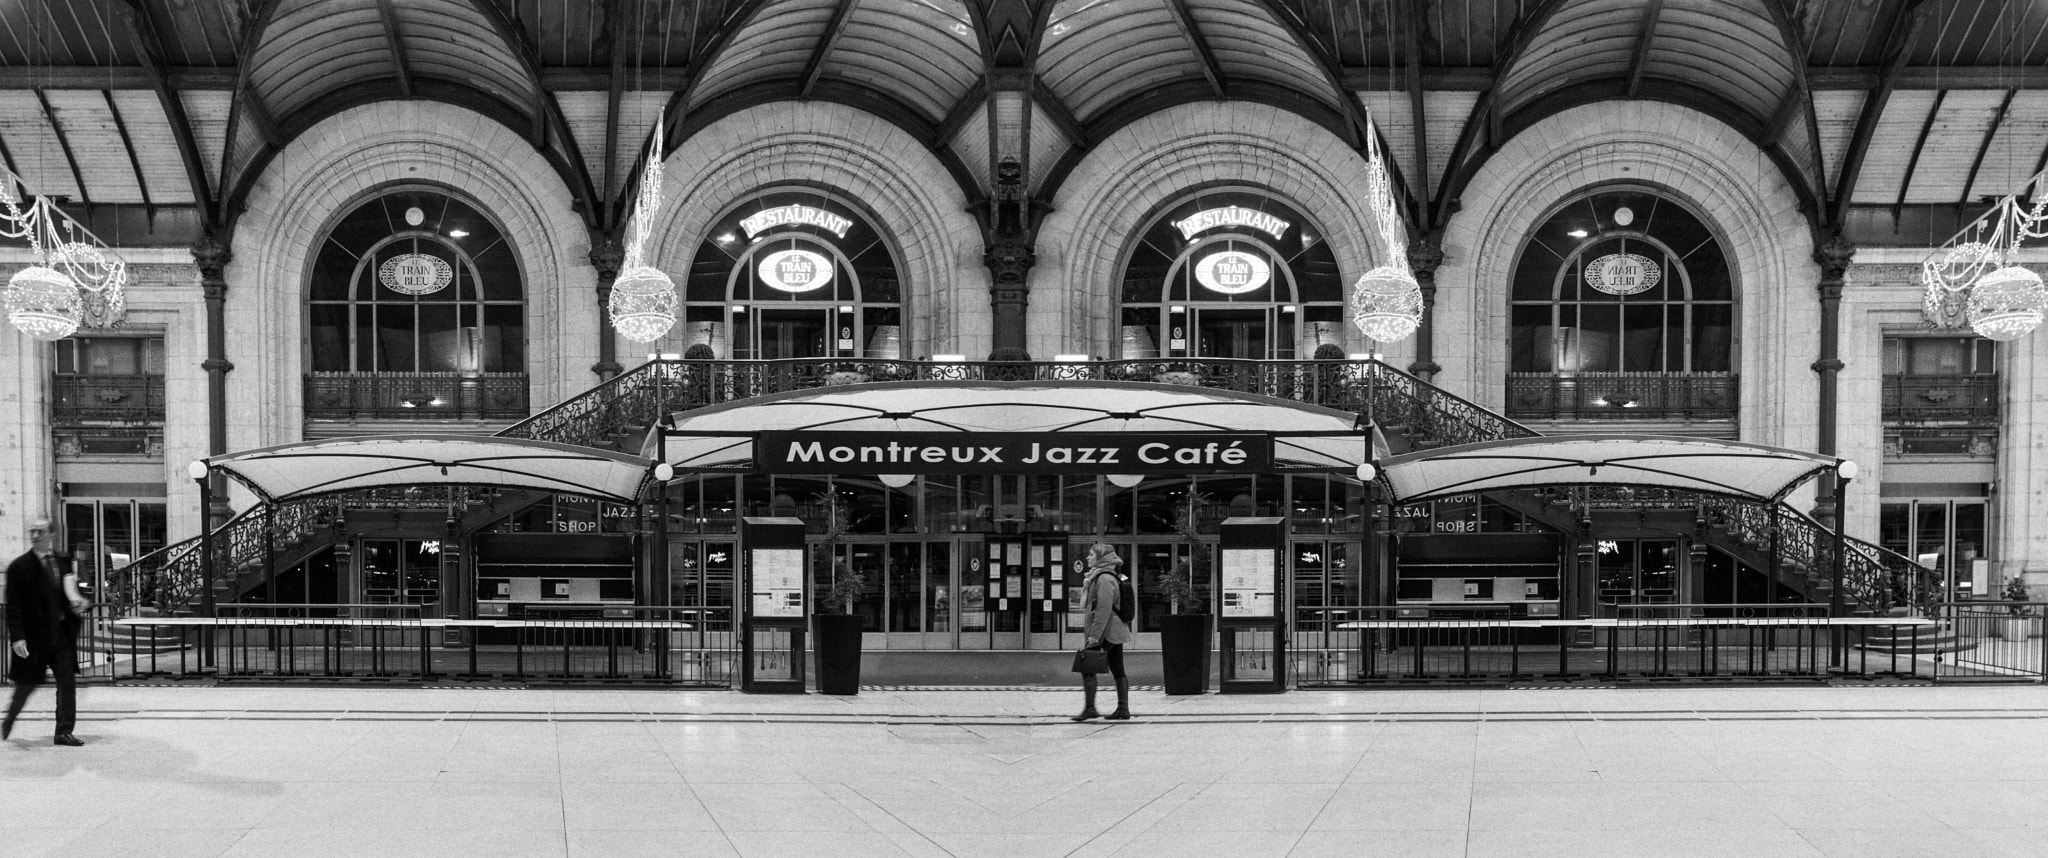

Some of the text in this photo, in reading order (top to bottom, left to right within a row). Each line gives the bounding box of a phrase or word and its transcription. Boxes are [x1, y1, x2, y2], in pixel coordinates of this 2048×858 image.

[744, 208, 846, 237] RESTAURANT
[1182, 209, 1283, 239] RESTAURANT
[401, 265, 431, 275] TRAIN
[781, 262, 811, 272] TRAIN
[1217, 263, 1248, 273] TRAIN
[404, 276, 430, 286] BLEU
[784, 273, 810, 283] BLEU
[1220, 274, 1247, 285] BLEU
[786, 440, 1248, 465] Montreux Jazz Café
[559, 521, 596, 532] SHOP
